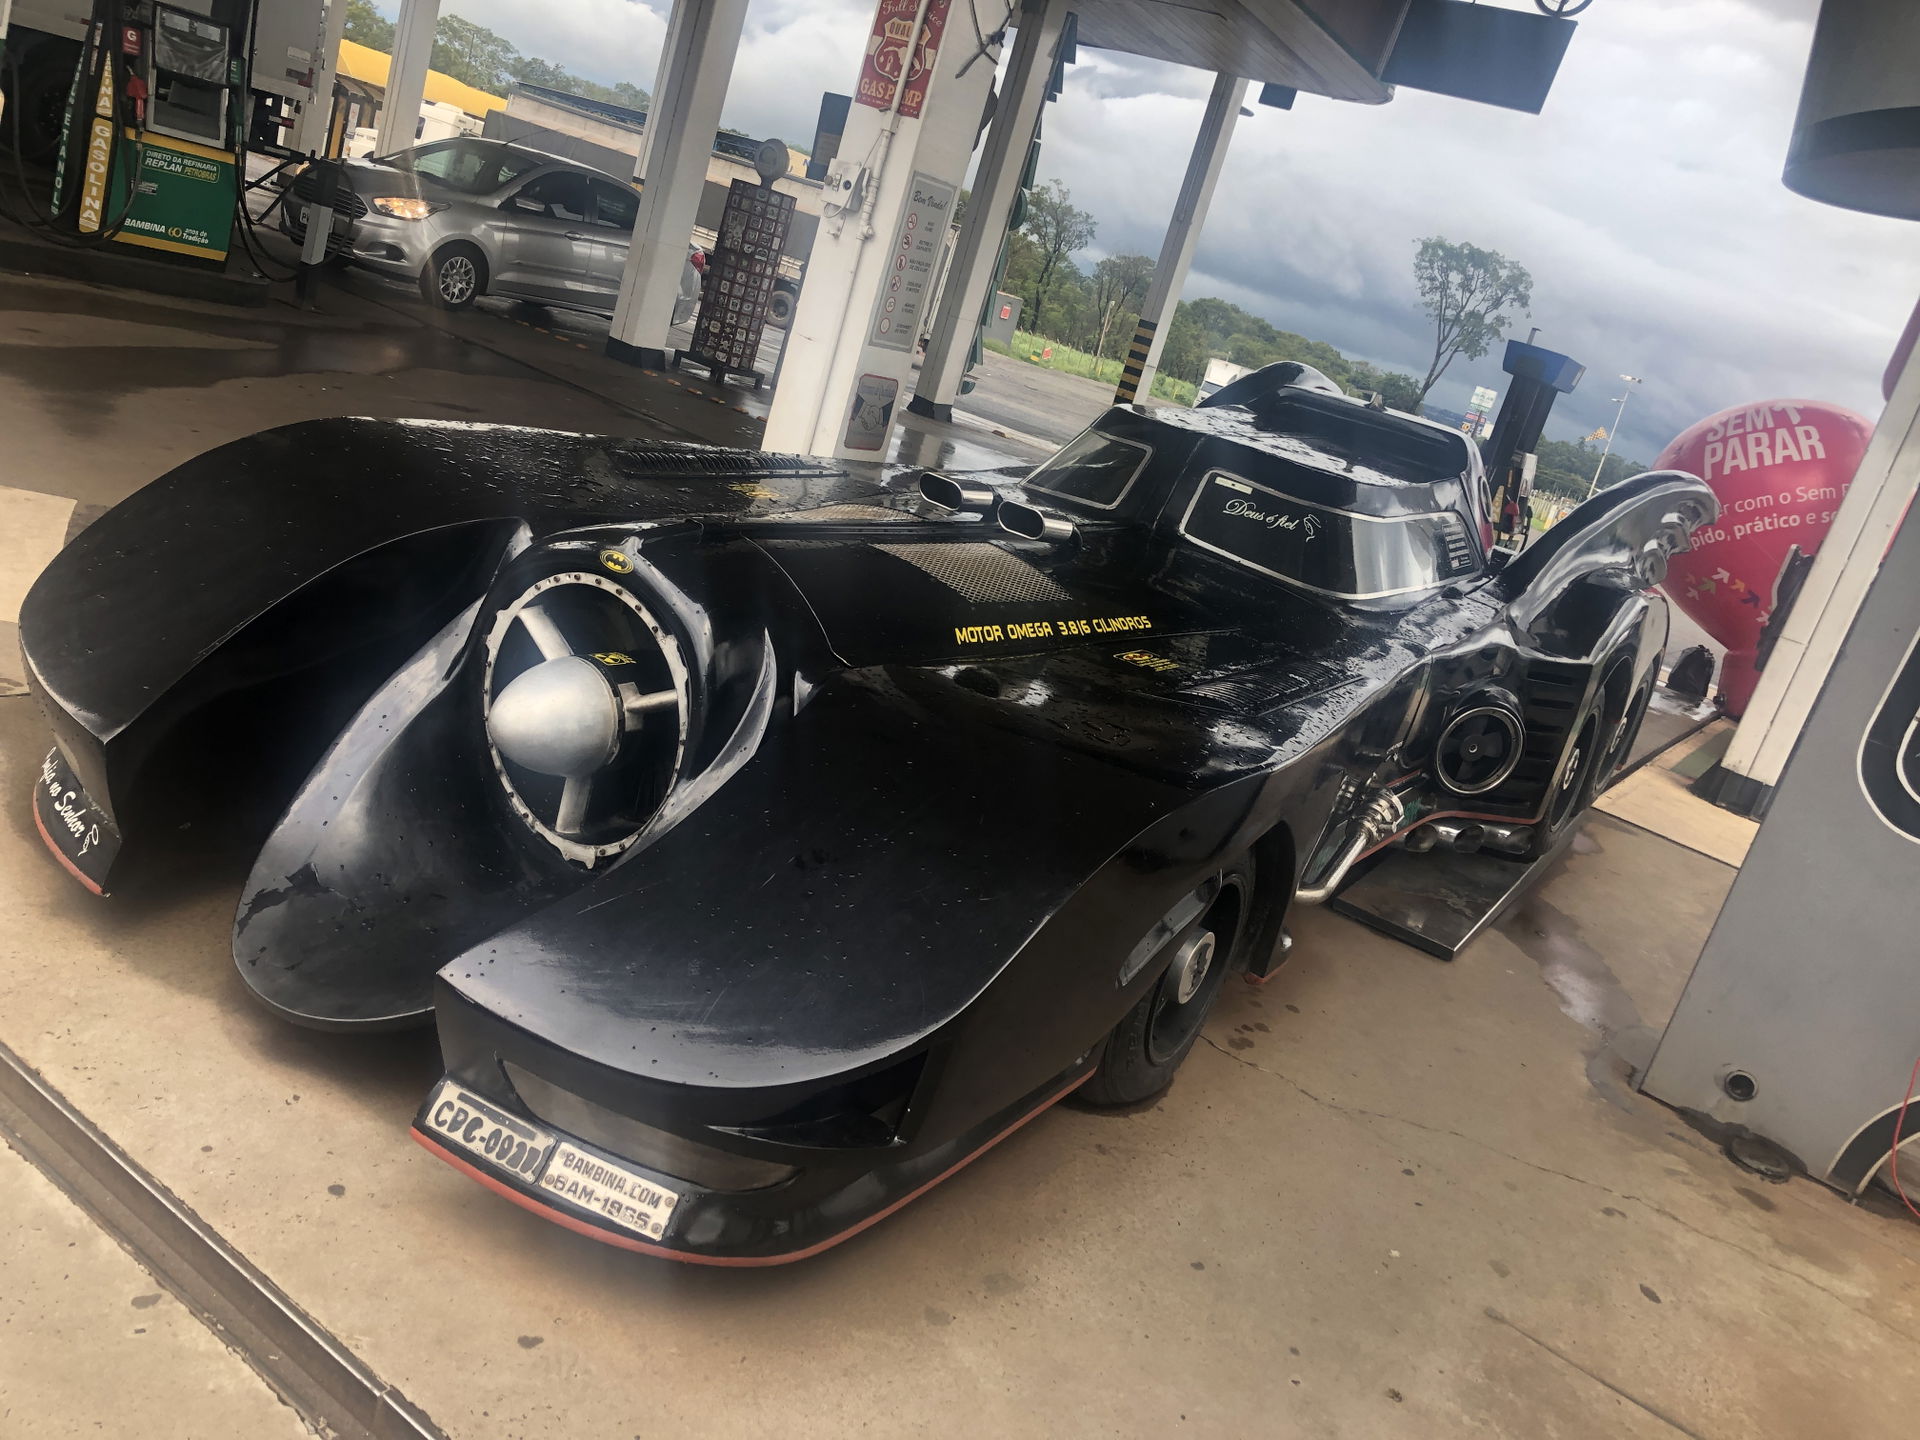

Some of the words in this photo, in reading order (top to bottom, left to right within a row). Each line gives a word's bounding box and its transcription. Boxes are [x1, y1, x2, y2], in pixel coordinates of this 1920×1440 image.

[127, 30, 137, 41] G
[860, 78, 884, 98] GAS
[885, 84, 922, 107] PMP
[53, 113, 72, 206] ETANOL
[81, 124, 111, 222] GASOLINA
[145, 157, 183, 173] REPLAN
[184, 166, 217, 180] PETROBRAS
[146, 150, 171, 161] DIRETO
[182, 158, 217, 172] REFINARIA
[124, 217, 166, 233] BAMBINA
[168, 226, 182, 238] 60
[182, 232, 208, 244] Tradição
[185, 228, 199, 236] anos
[1706, 406, 1774, 442] SEM
[1703, 425, 1826, 480] PARAR
[1222, 498, 1266, 521] Deus
[1267, 514, 1300, 530] fiel
[1734, 494, 1774, 513] com
[1779, 492, 1791, 504] o
[1795, 486, 1836, 503] Sem
[1690, 527, 1731, 551] pido,
[1733, 512, 1801, 540] prático
[1806, 512, 1816, 525] e
[955, 624, 1004, 645] MOTOR
[1007, 621, 1053, 640] OMEGA
[1092, 616, 1152, 633] CILINDROS
[54, 790, 87, 838] Senhor
[562, 1151, 663, 1209] BAMBINA.COM
